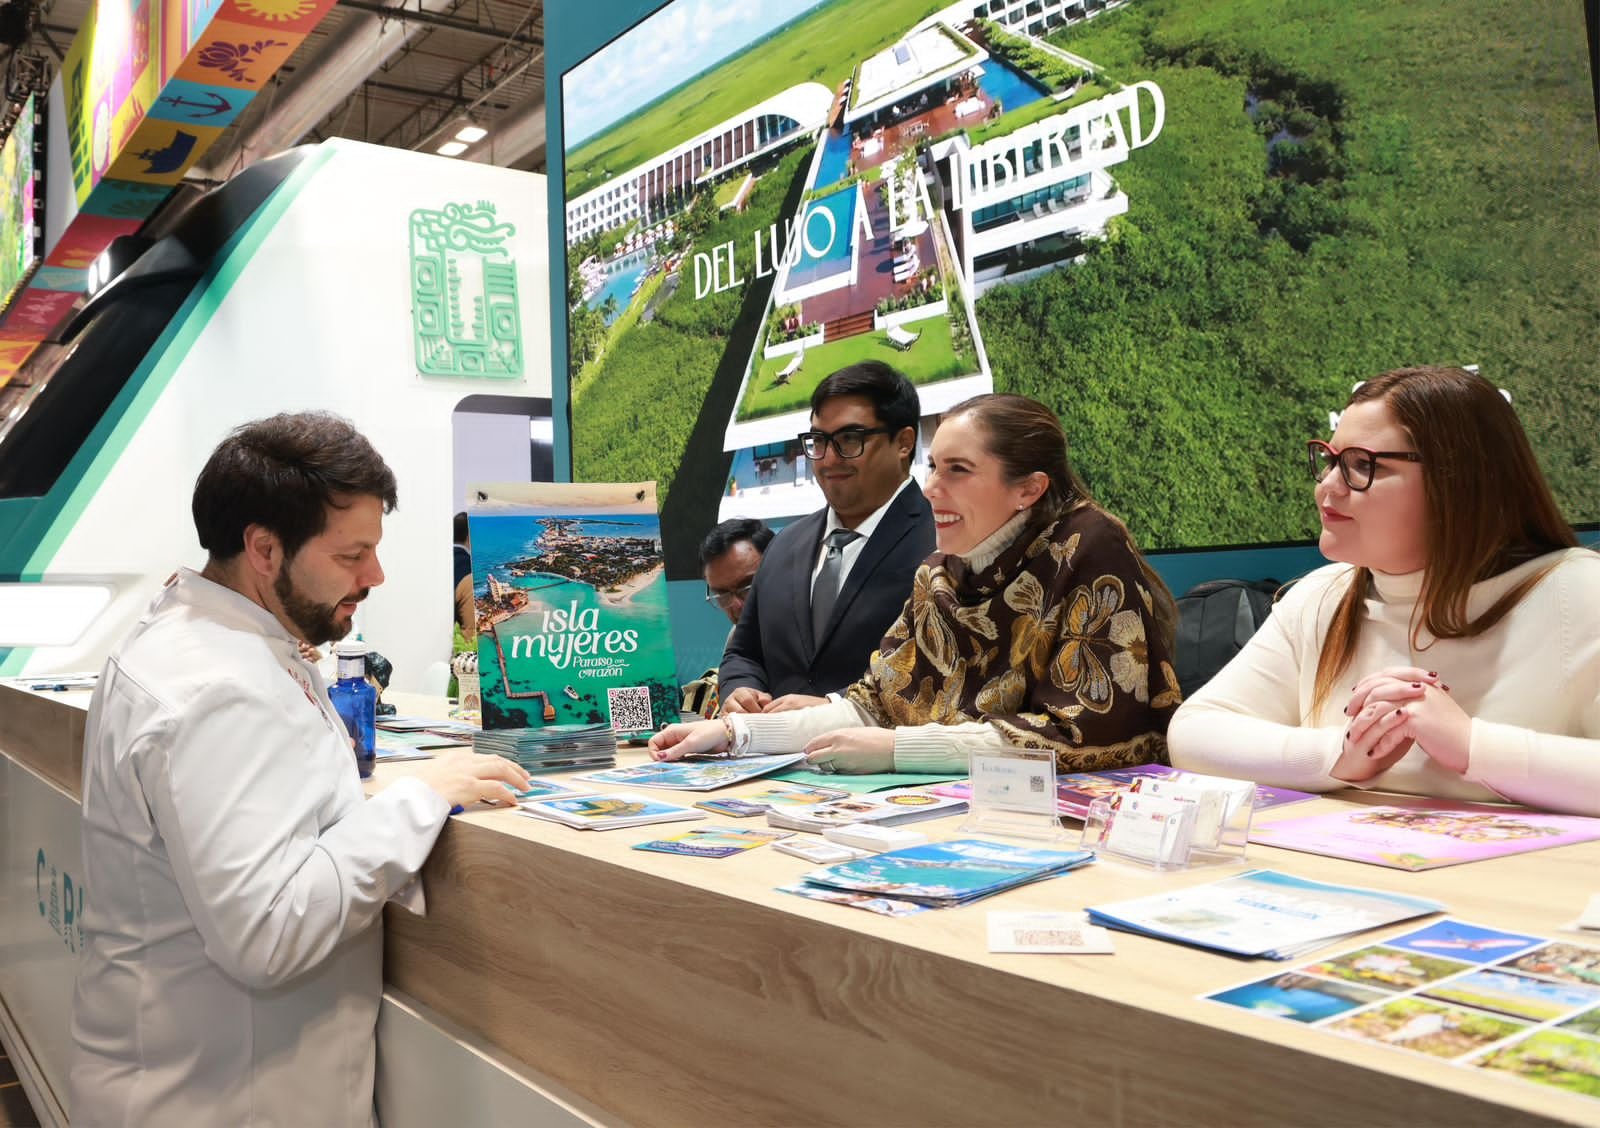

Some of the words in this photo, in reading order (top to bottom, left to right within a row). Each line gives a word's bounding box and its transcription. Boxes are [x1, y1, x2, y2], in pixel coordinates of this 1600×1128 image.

[693, 240, 745, 300] DEL
[849, 178, 876, 249] A
[886, 166, 936, 232] LA
[511, 629, 638, 669] mujeres
